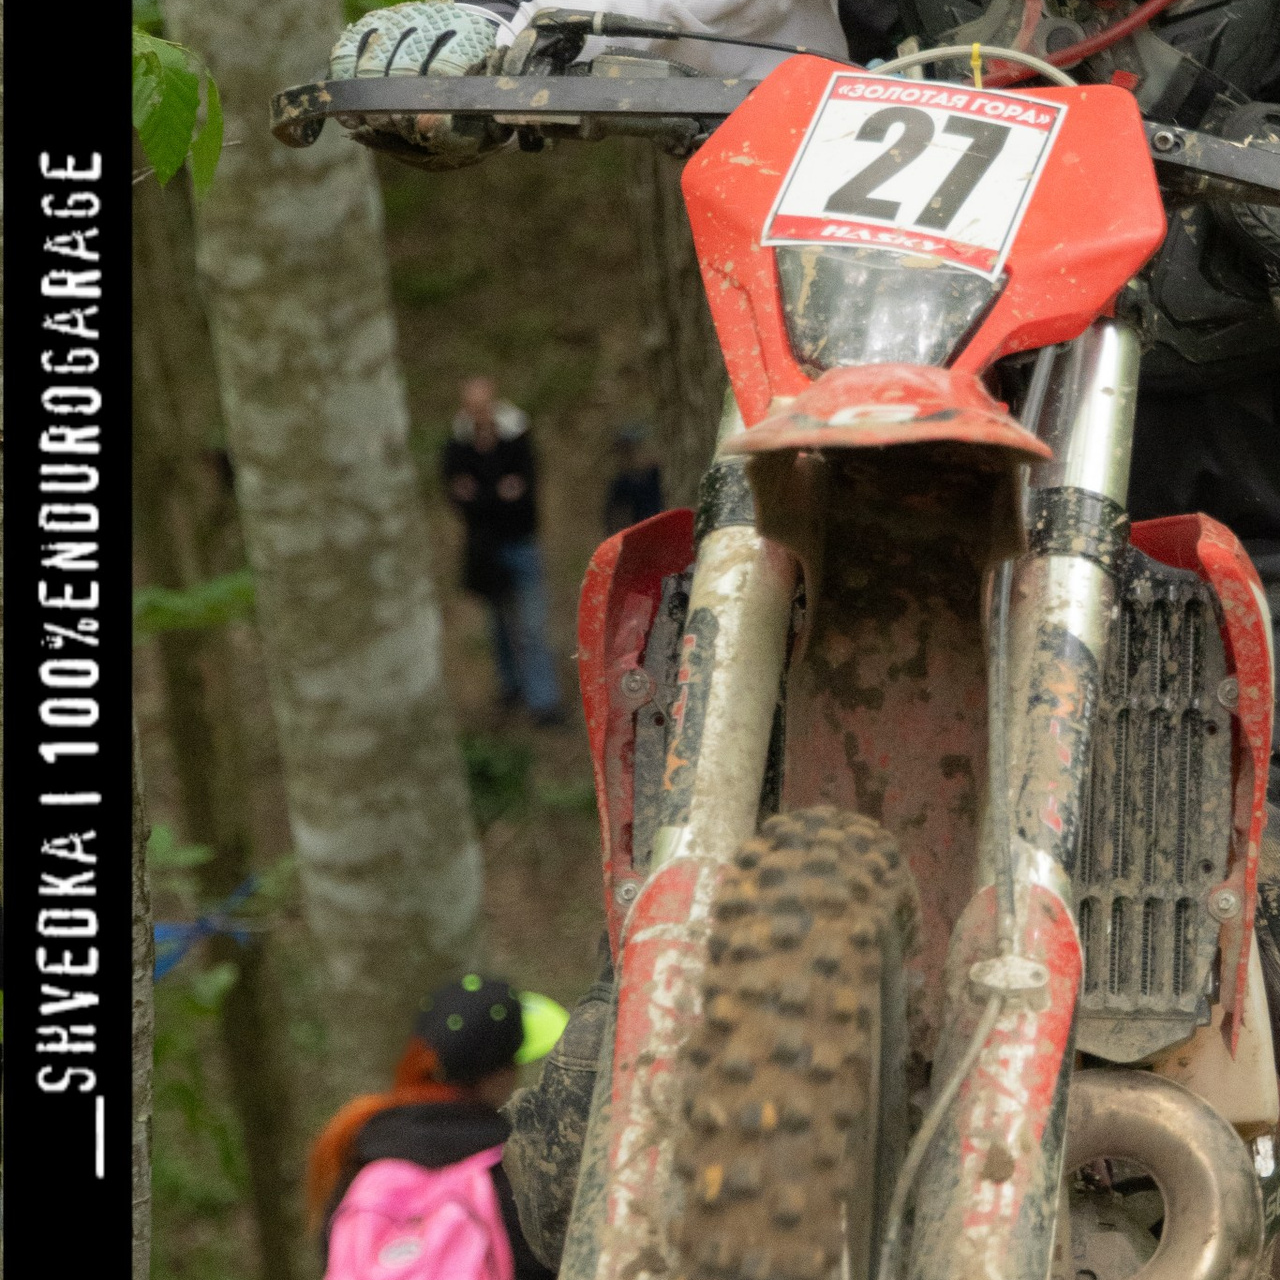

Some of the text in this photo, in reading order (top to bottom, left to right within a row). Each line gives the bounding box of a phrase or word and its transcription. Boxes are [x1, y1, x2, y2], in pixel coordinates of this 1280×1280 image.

[837, 83, 1052, 125] «ЗОЛОТАЯ ГОРА»
[822, 106, 1012, 231] 27
[820, 224, 945, 252] HASKY
